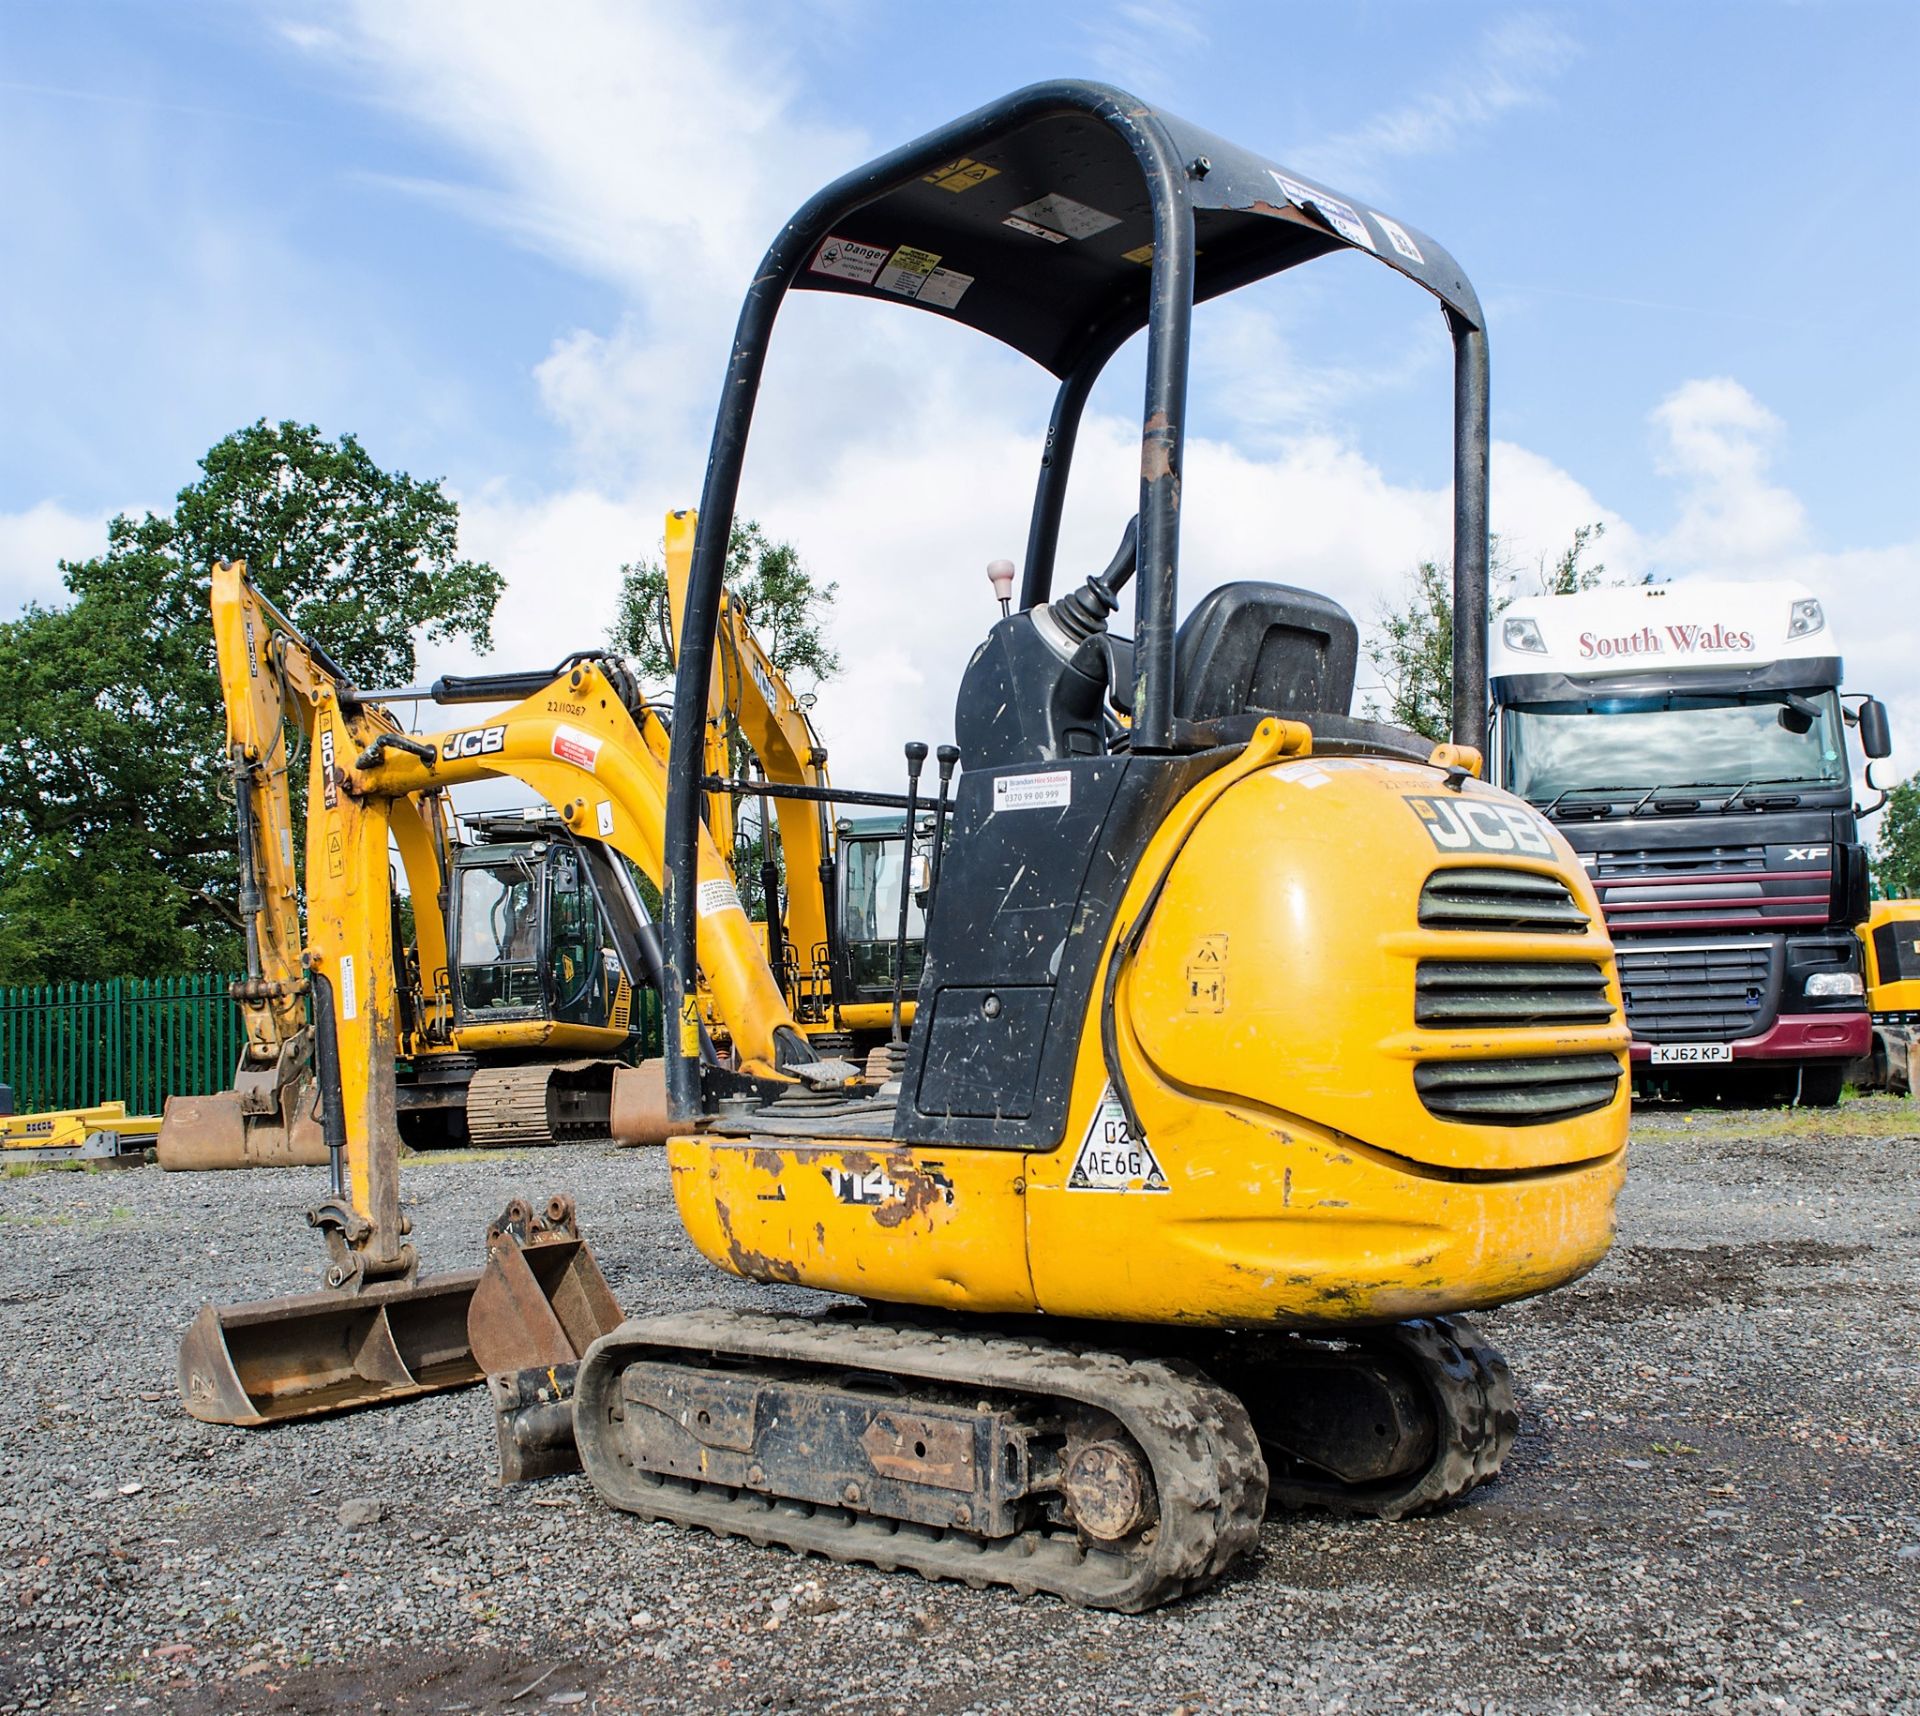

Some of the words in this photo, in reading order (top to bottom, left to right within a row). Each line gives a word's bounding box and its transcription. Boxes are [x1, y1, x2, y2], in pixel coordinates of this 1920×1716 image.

[844, 242, 887, 261] Danger
[1579, 626, 1662, 659] South
[1665, 623, 1754, 652] Wales
[442, 725, 507, 761] JCB
[320, 730, 337, 798] 8014
[1005, 793, 1023, 802] 0370
[1023, 792, 1033, 800] 99
[1034, 791, 1044, 799] 00
[1045, 790, 1059, 799] 999
[1427, 799, 1552, 855] JCB
[1783, 848, 1829, 860] XF
[1661, 1047, 1698, 1061] KJ62
[1701, 1047, 1730, 1060] KPJ
[1104, 1121, 1130, 1144] 02
[1088, 1151, 1141, 1175] AE6G
